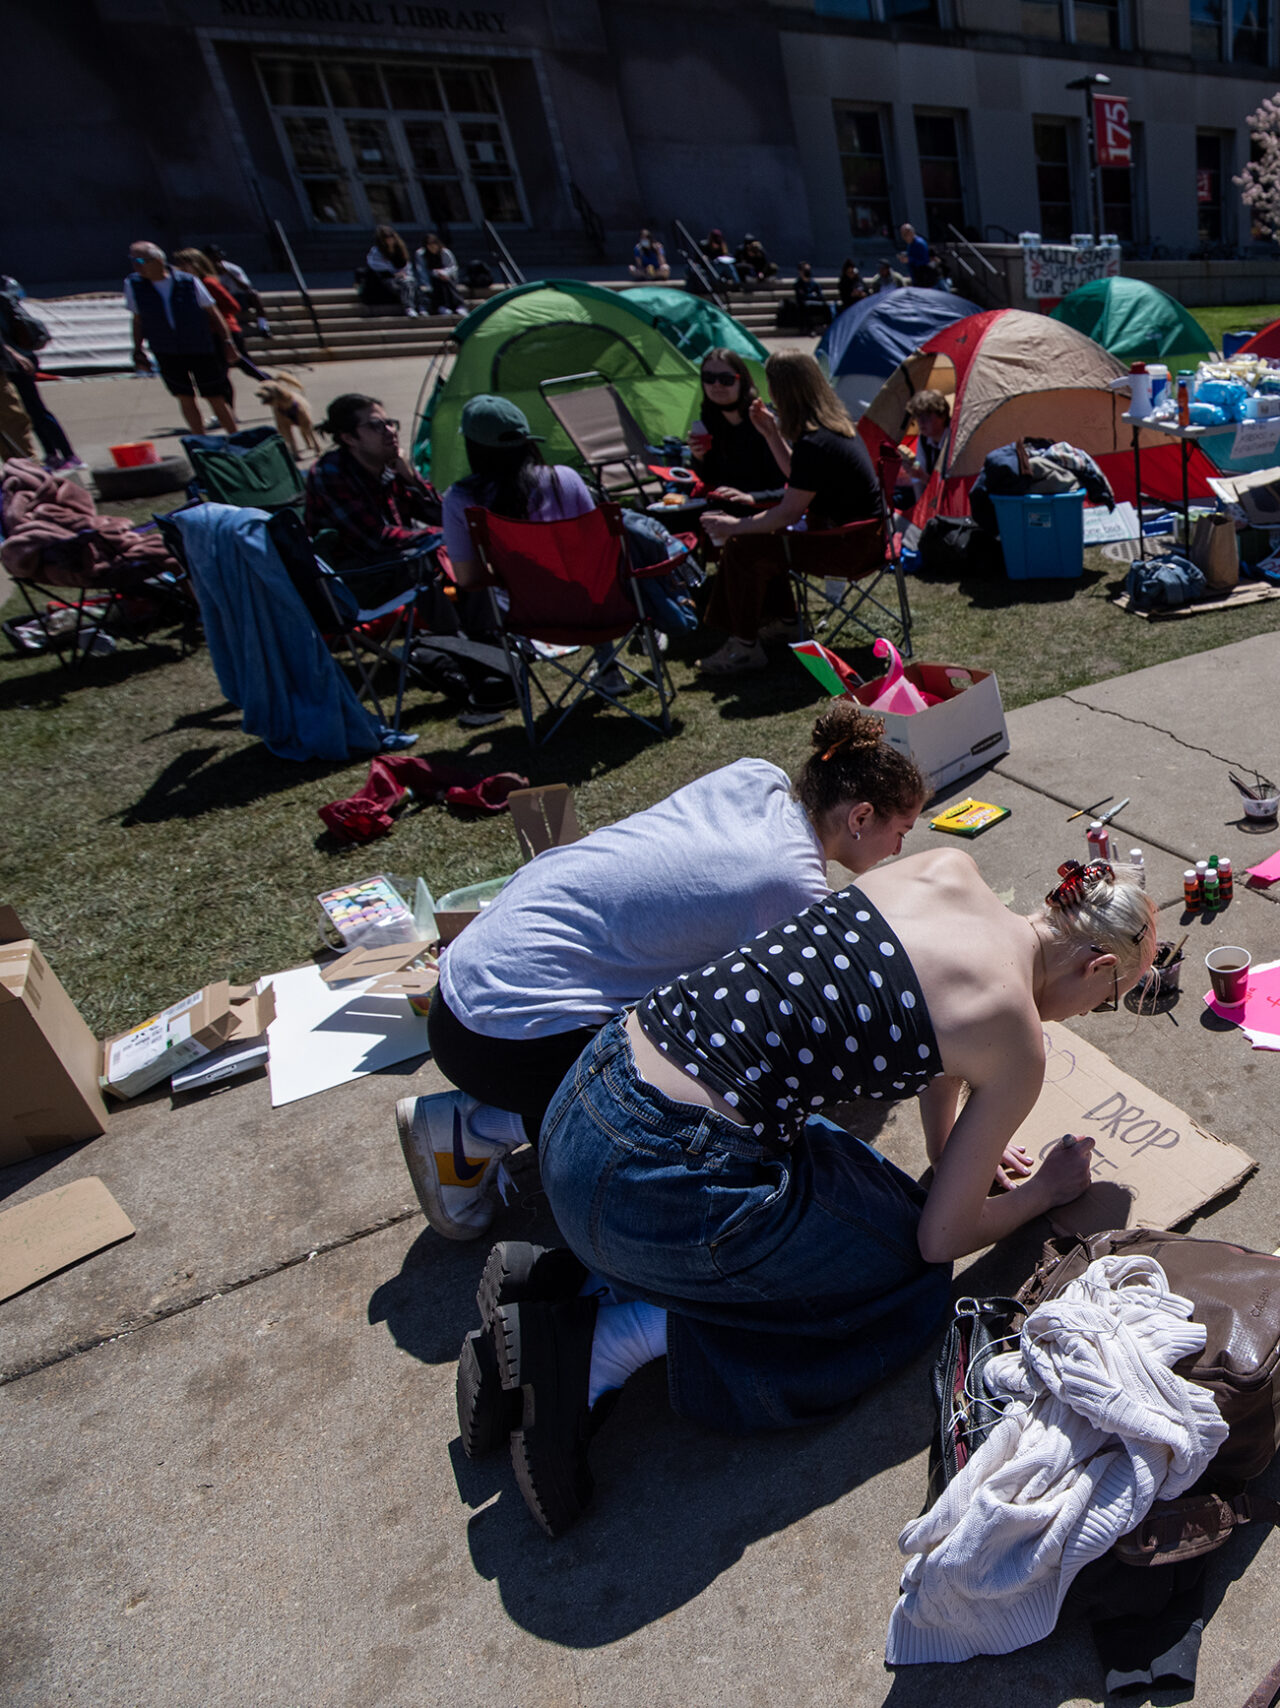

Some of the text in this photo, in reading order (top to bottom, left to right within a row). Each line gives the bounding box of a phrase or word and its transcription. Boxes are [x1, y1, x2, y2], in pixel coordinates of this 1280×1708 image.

[389, 4, 508, 34] LIBRARY
[1104, 102, 1132, 161] 175
[1028, 248, 1112, 268] FACULTY STAFF
[1040, 264, 1104, 282] SUPPORT
[1032, 279, 1054, 295] OUR
[1081, 1091, 1181, 1158] DROP
